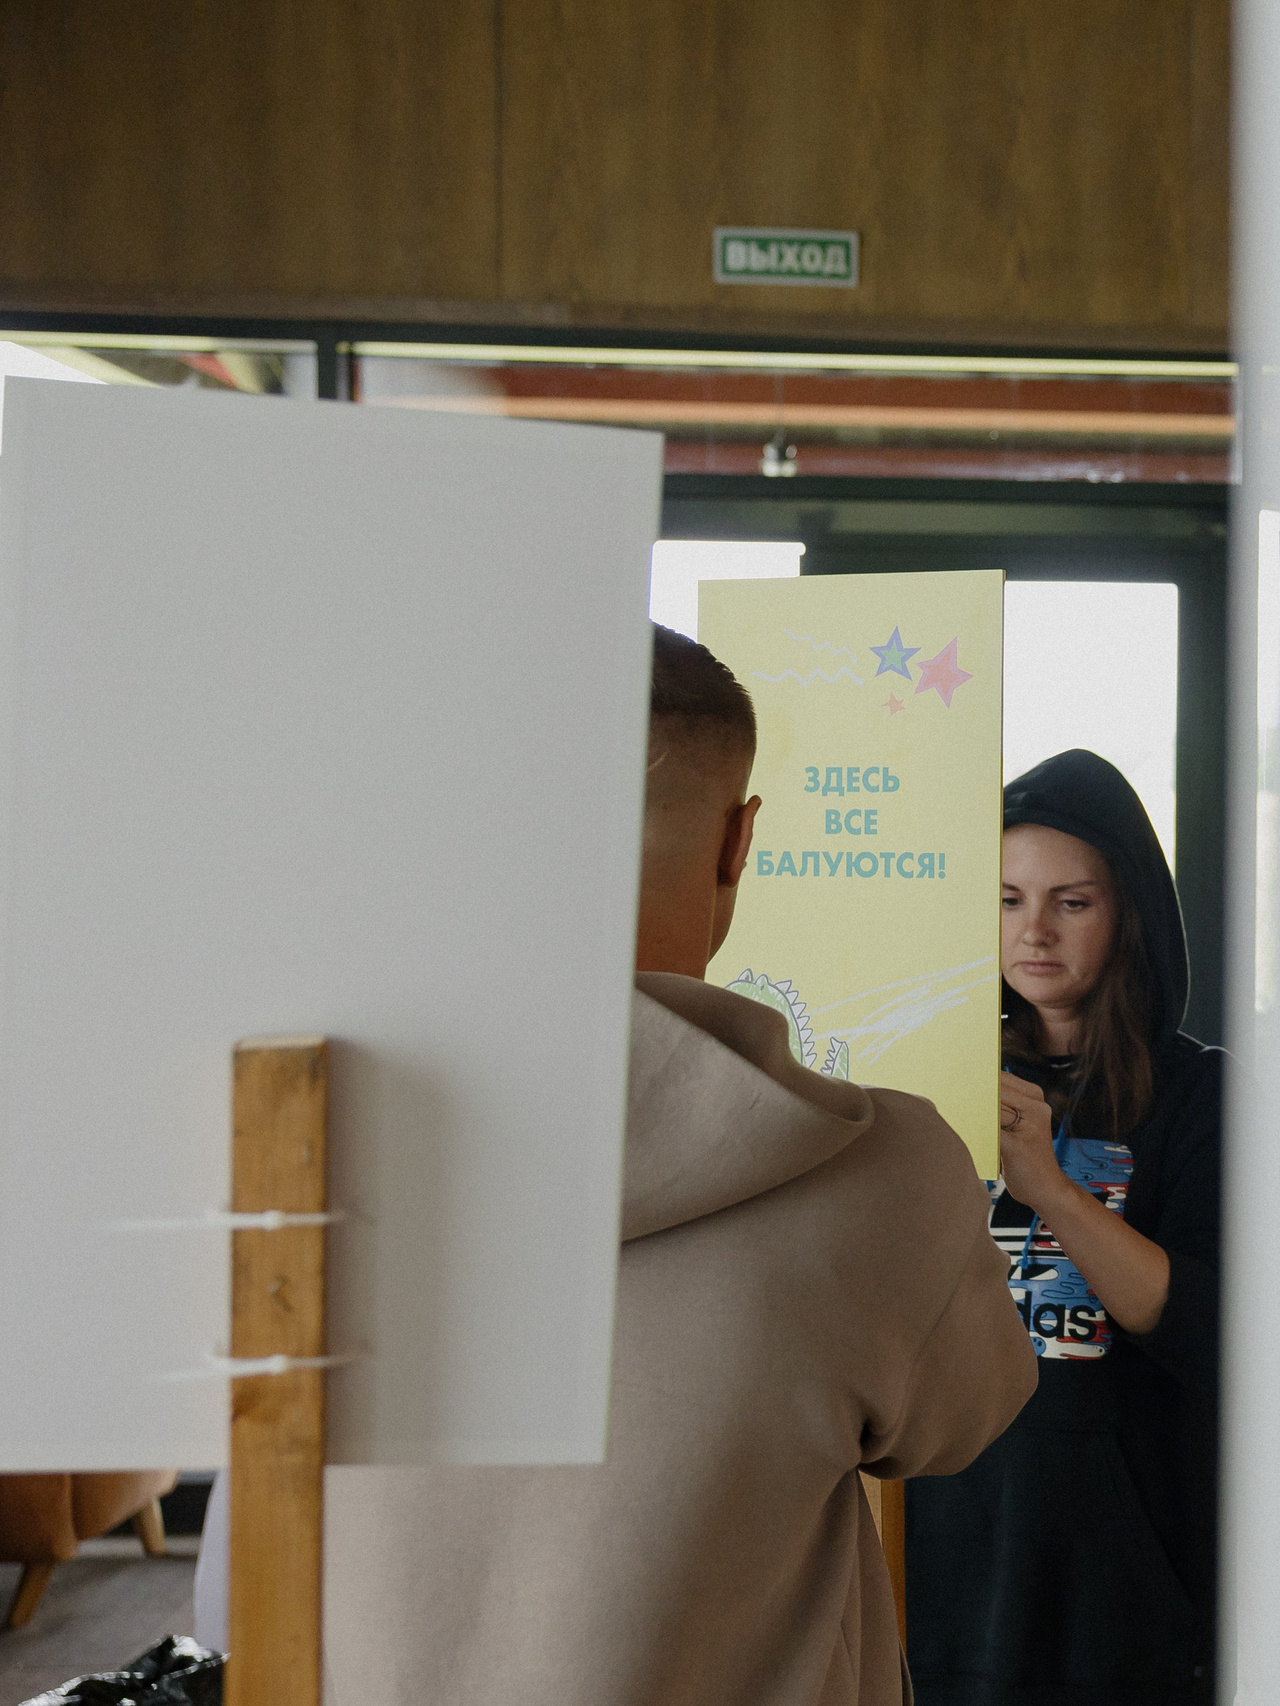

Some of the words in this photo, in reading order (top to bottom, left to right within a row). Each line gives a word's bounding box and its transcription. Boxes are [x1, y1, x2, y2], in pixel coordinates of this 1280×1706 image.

[726, 241, 847, 274] ВЫХОД
[804, 766, 900, 796] ЗДЕСЬ
[825, 809, 878, 835] ВСЕ
[757, 851, 947, 879] БАЛУЮТСЯ!
